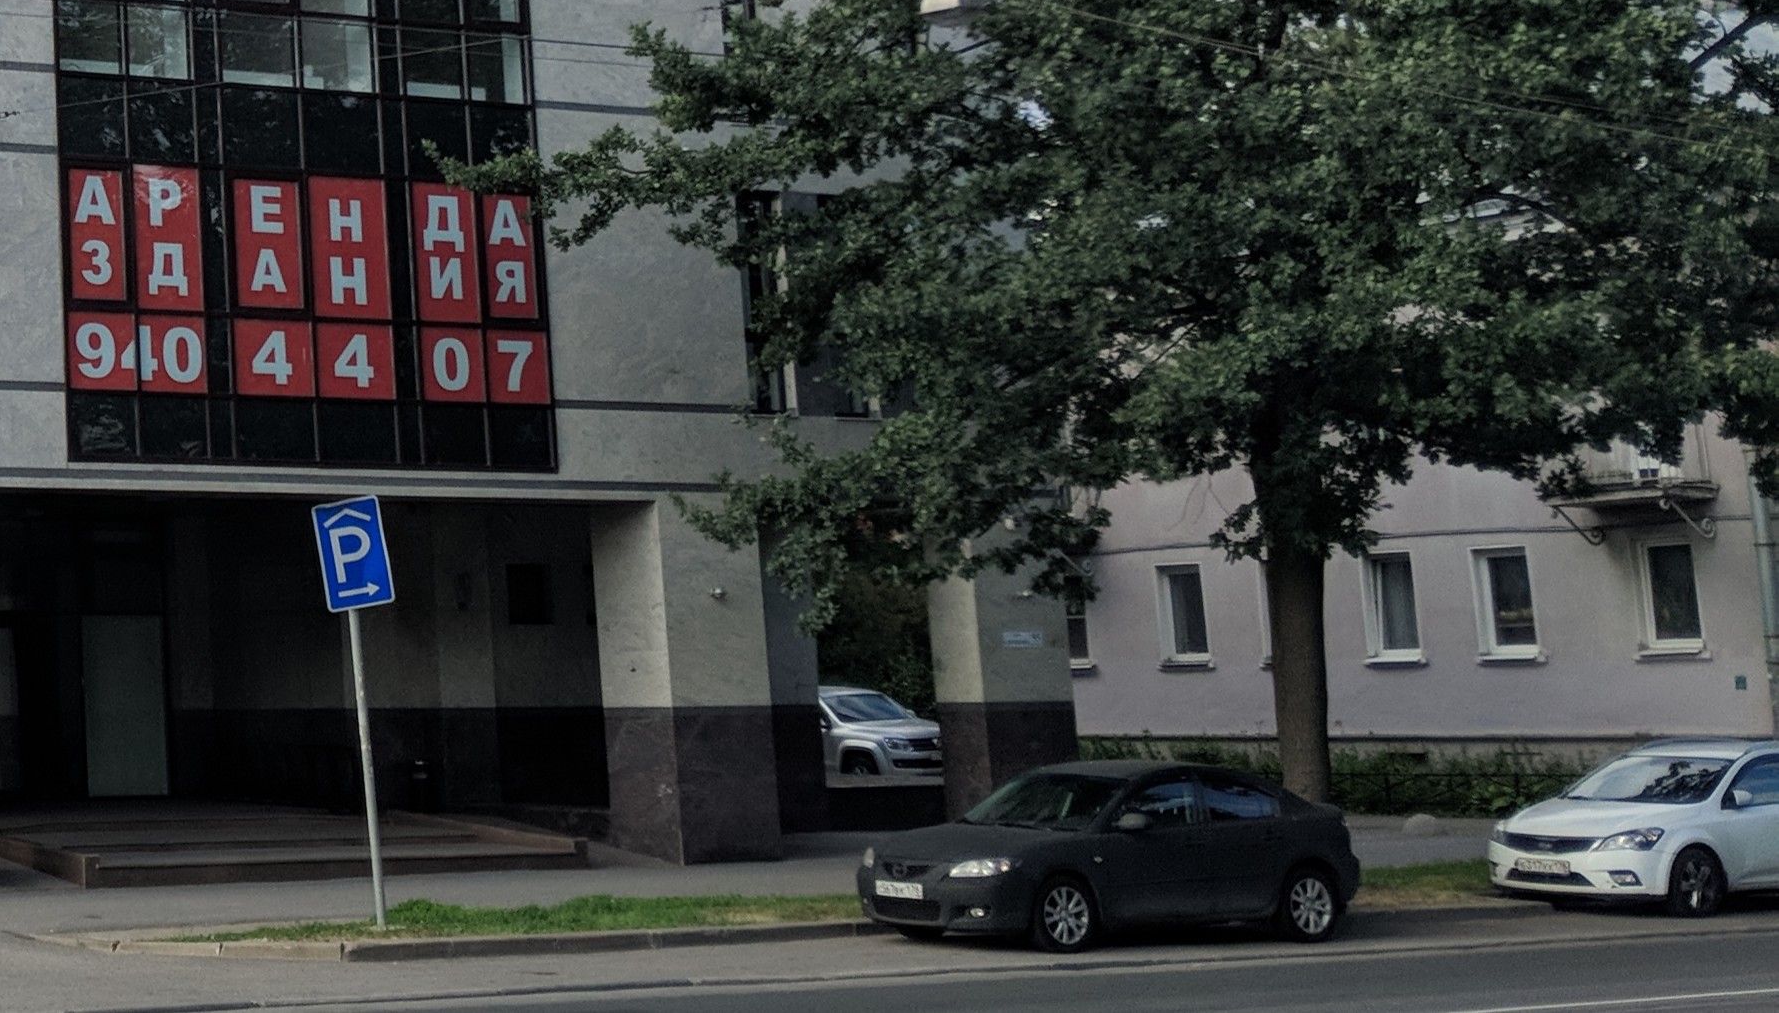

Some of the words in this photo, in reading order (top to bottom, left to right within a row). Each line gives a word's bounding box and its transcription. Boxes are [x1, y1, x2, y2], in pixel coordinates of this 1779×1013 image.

[73, 174, 527, 254] АРЕНДА
[80, 238, 527, 305] ЗДАНИЯ
[74, 321, 204, 384] 940
[329, 526, 371, 584] P
